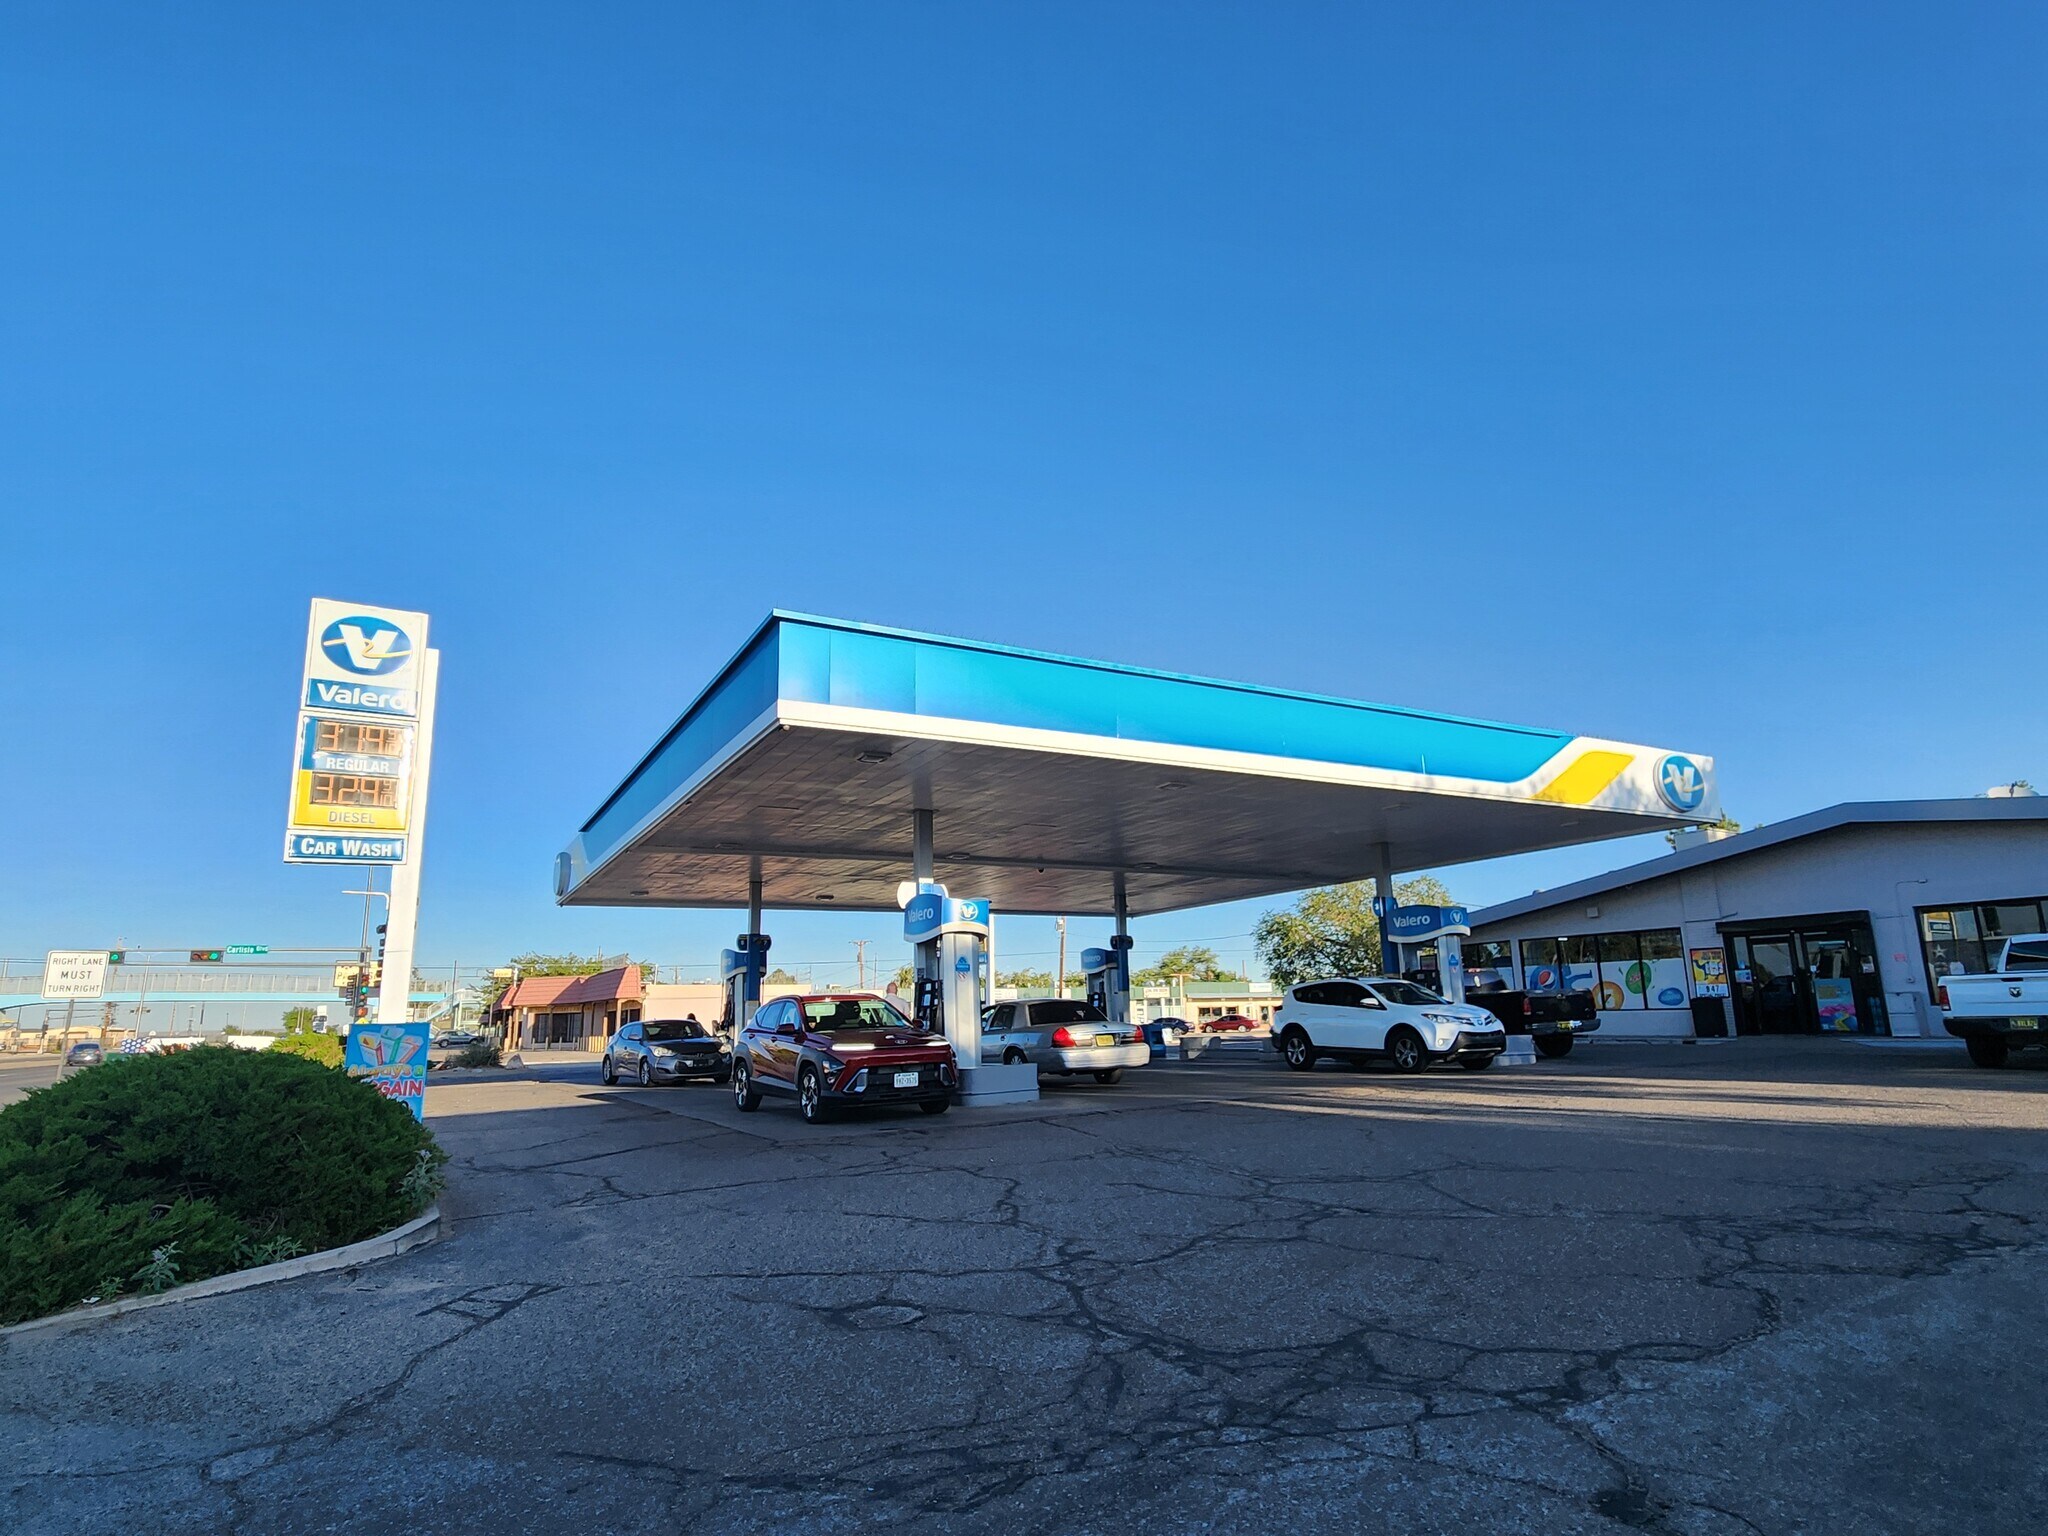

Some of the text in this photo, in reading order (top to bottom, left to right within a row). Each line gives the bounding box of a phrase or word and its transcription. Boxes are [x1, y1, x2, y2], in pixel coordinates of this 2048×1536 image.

[316, 683, 405, 710] Valero
[325, 757, 390, 774] REGULAR
[328, 811, 377, 825] DIESEL
[301, 838, 393, 857] CAR WASH
[907, 907, 934, 923] Valero
[1393, 915, 1431, 928] Valero
[226, 945, 254, 954] Carlisle
[52, 957, 104, 966] RIGHT LANE
[60, 970, 93, 980] MUST
[47, 984, 101, 993] TURN RIGHT
[347, 1063, 412, 1079] Always
